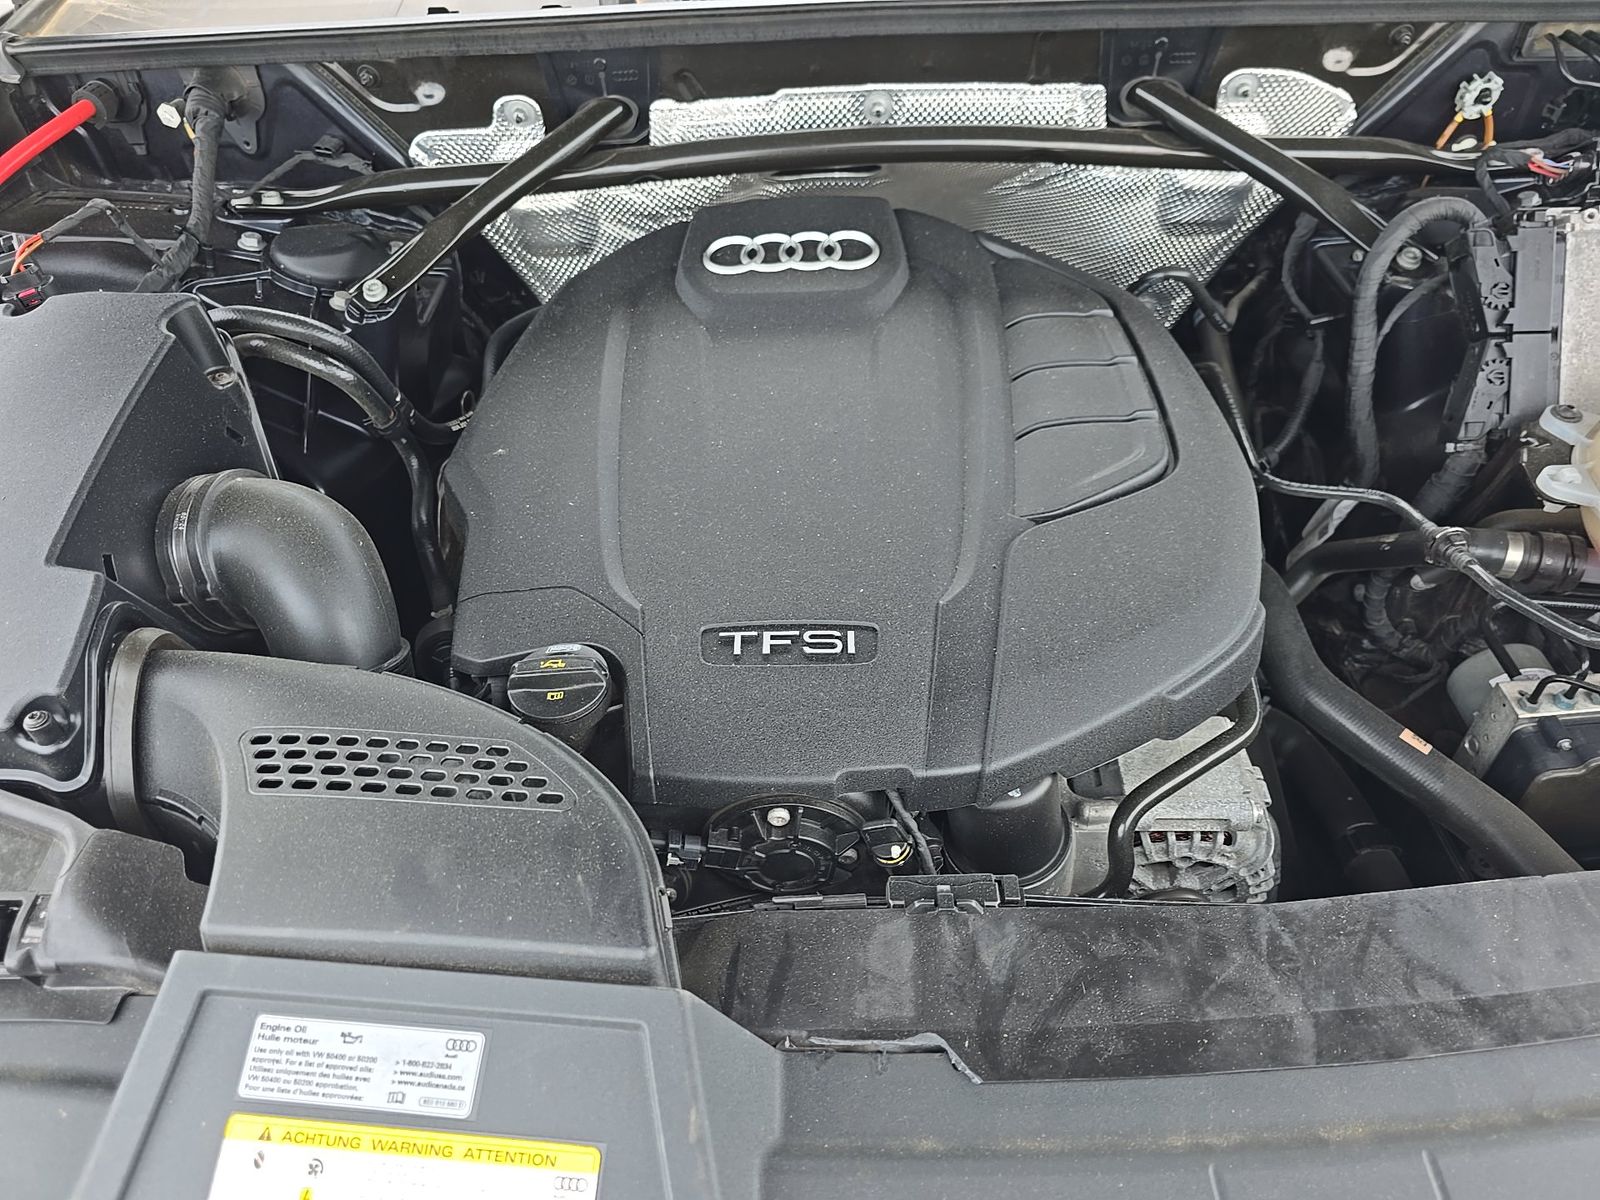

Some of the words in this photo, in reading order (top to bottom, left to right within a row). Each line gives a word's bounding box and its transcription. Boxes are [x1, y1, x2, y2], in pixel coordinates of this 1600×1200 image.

[718, 630, 856, 655] TFSI
[260, 1022, 292, 1033] Engine
[294, 1024, 308, 1034] Oil
[258, 1033, 281, 1042] Huile
[283, 1036, 319, 1045] moteur
[254, 1046, 267, 1054] Use
[268, 1048, 284, 1057] only
[296, 1050, 310, 1058] with
[312, 1051, 325, 1059] VW
[285, 1058, 297, 1066] For
[304, 1060, 315, 1068] list
[316, 1061, 324, 1069] of
[325, 1063, 359, 1072] approved
[248, 1074, 260, 1082] VW
[275, 1068, 317, 1078] uniquement
[318, 1071, 331, 1079] des
[332, 1072, 353, 1081] huiles
[400, 1070, 463, 1081] www.audiusa.com
[244, 1083, 260, 1092] Pour
[276, 1086, 291, 1095] liste
[292, 1088, 320, 1097] d'huiles
[397, 1079, 466, 1091] www.audicanada.ca
[281, 1131, 362, 1149] ACHTUNG
[372, 1139, 453, 1158] WARNING
[463, 1147, 558, 1168] ATTENTION
